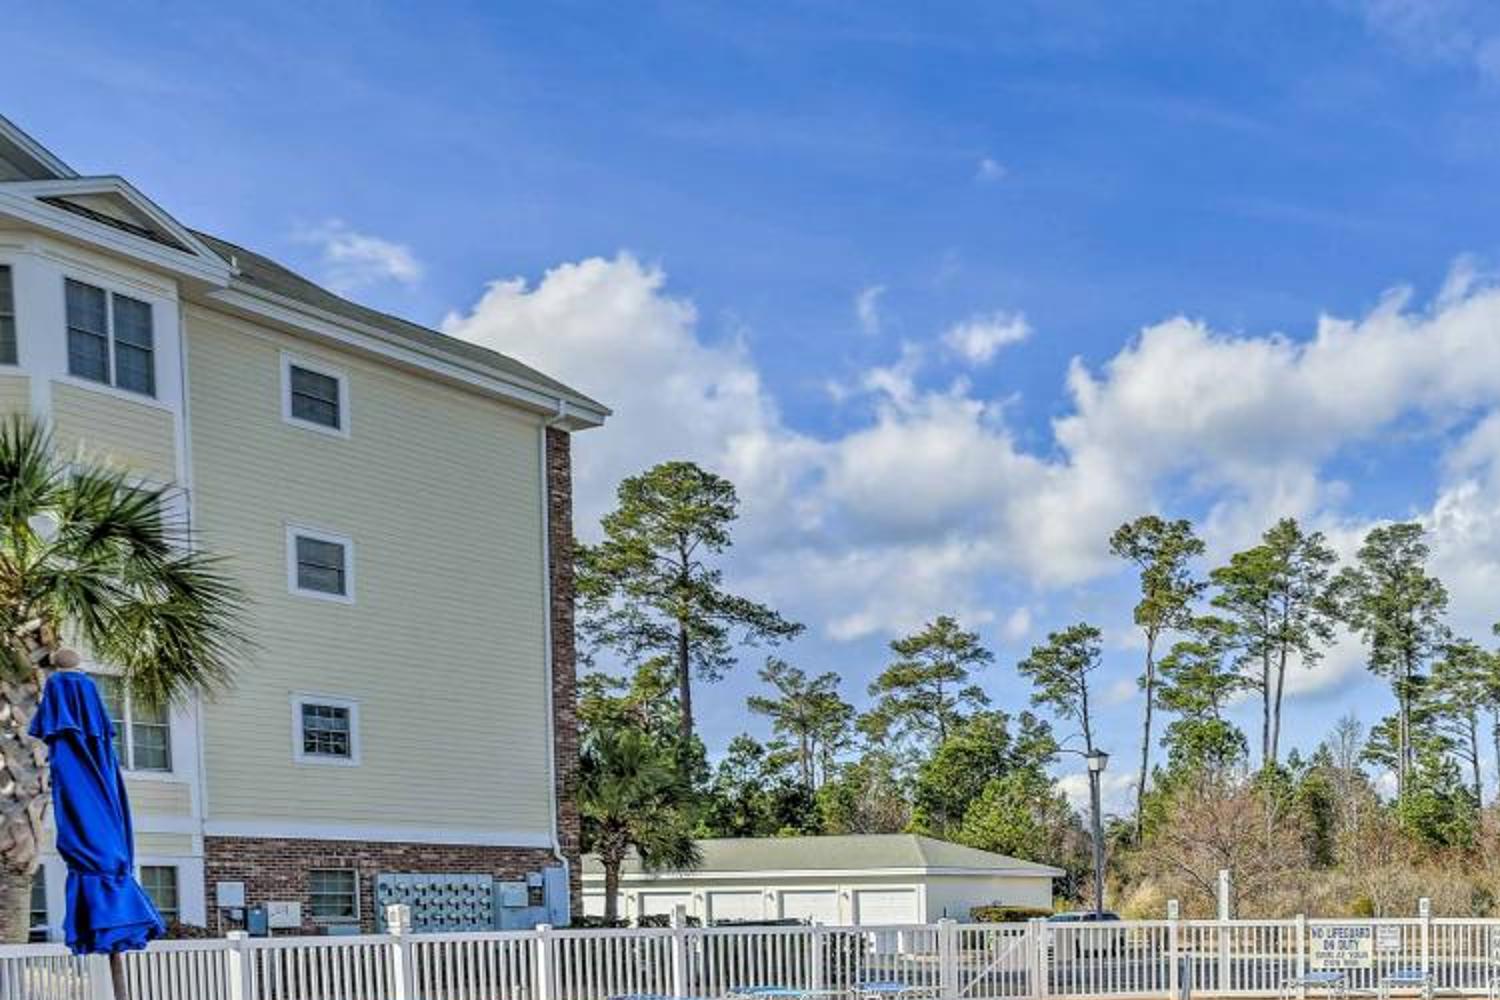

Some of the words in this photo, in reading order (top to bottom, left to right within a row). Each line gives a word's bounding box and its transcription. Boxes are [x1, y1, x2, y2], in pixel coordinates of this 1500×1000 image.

[1311, 927, 1324, 939] NO
[1327, 927, 1370, 939] LIFEGUARD
[1323, 939, 1335, 951] ON
[1338, 939, 1359, 951] DUTY
